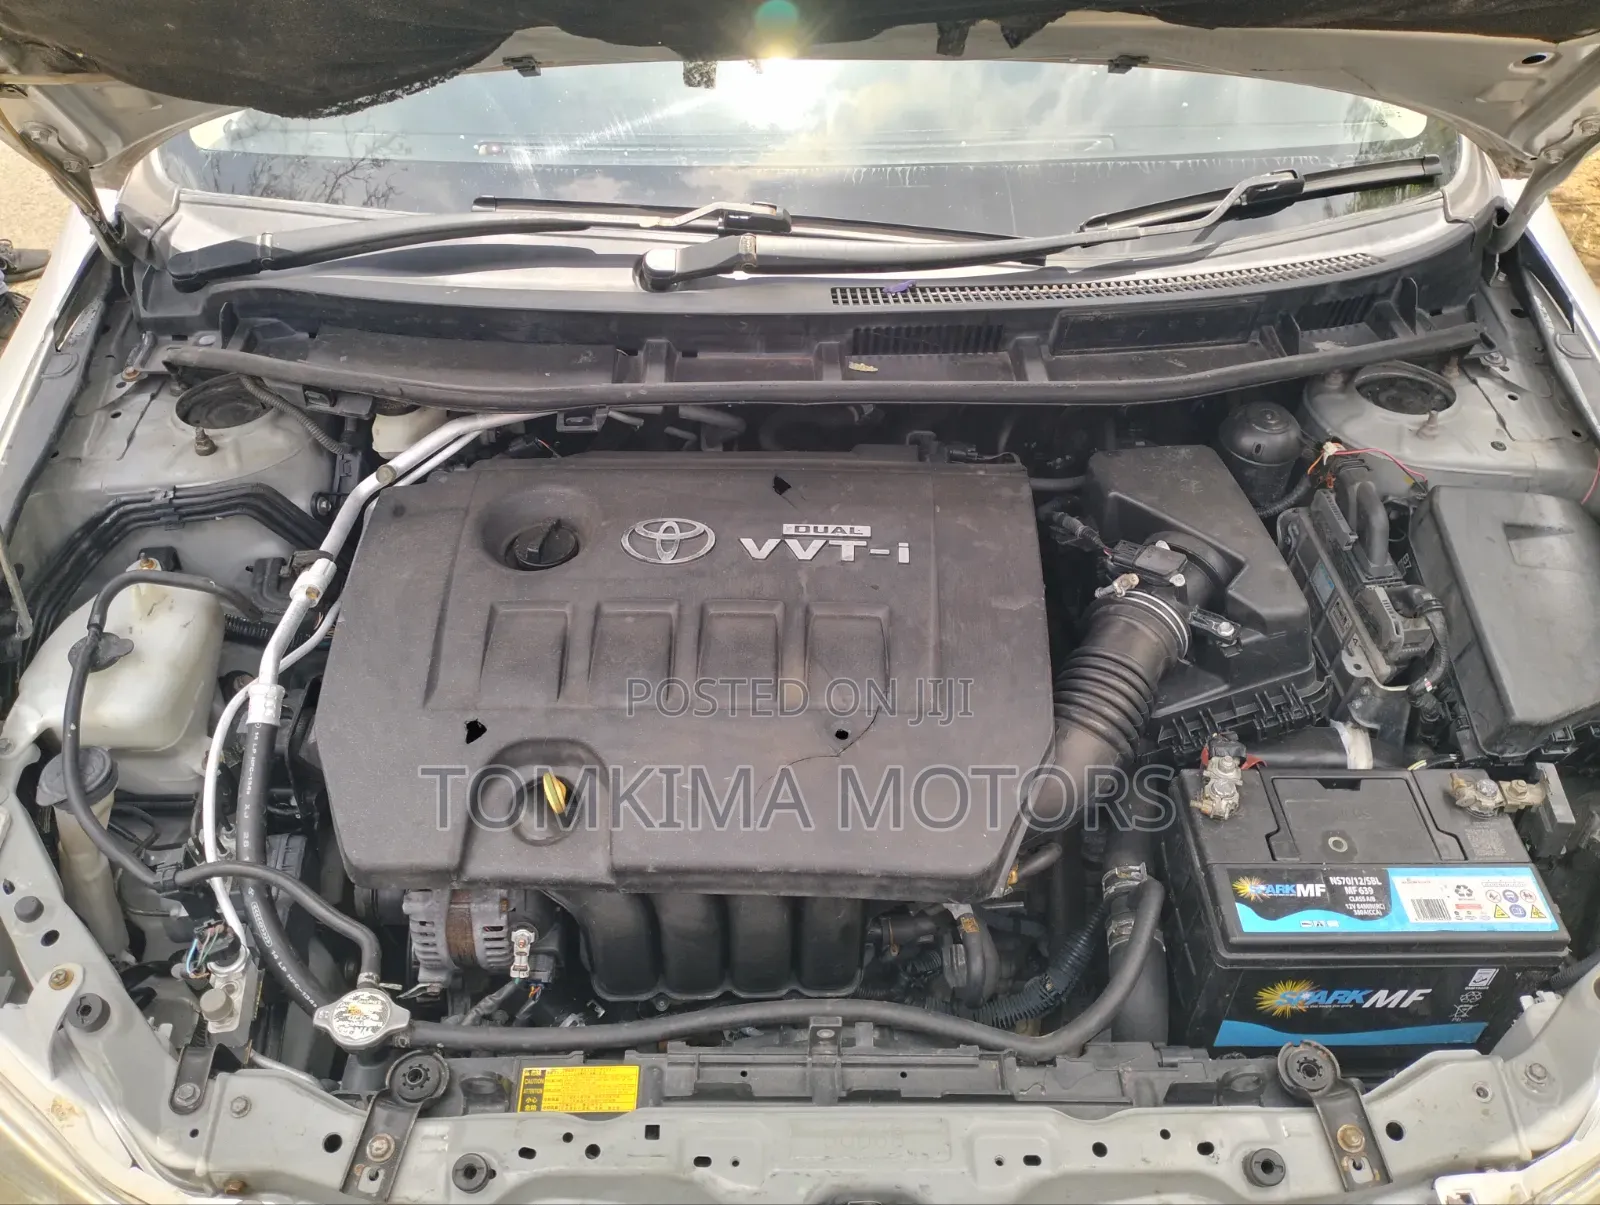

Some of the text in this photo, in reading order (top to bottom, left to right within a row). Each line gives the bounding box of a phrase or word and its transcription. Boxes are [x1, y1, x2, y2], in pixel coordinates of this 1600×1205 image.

[794, 525, 864, 535] DUAL
[739, 538, 910, 564] VVT-i
[1344, 886, 1374, 895] MF 639
